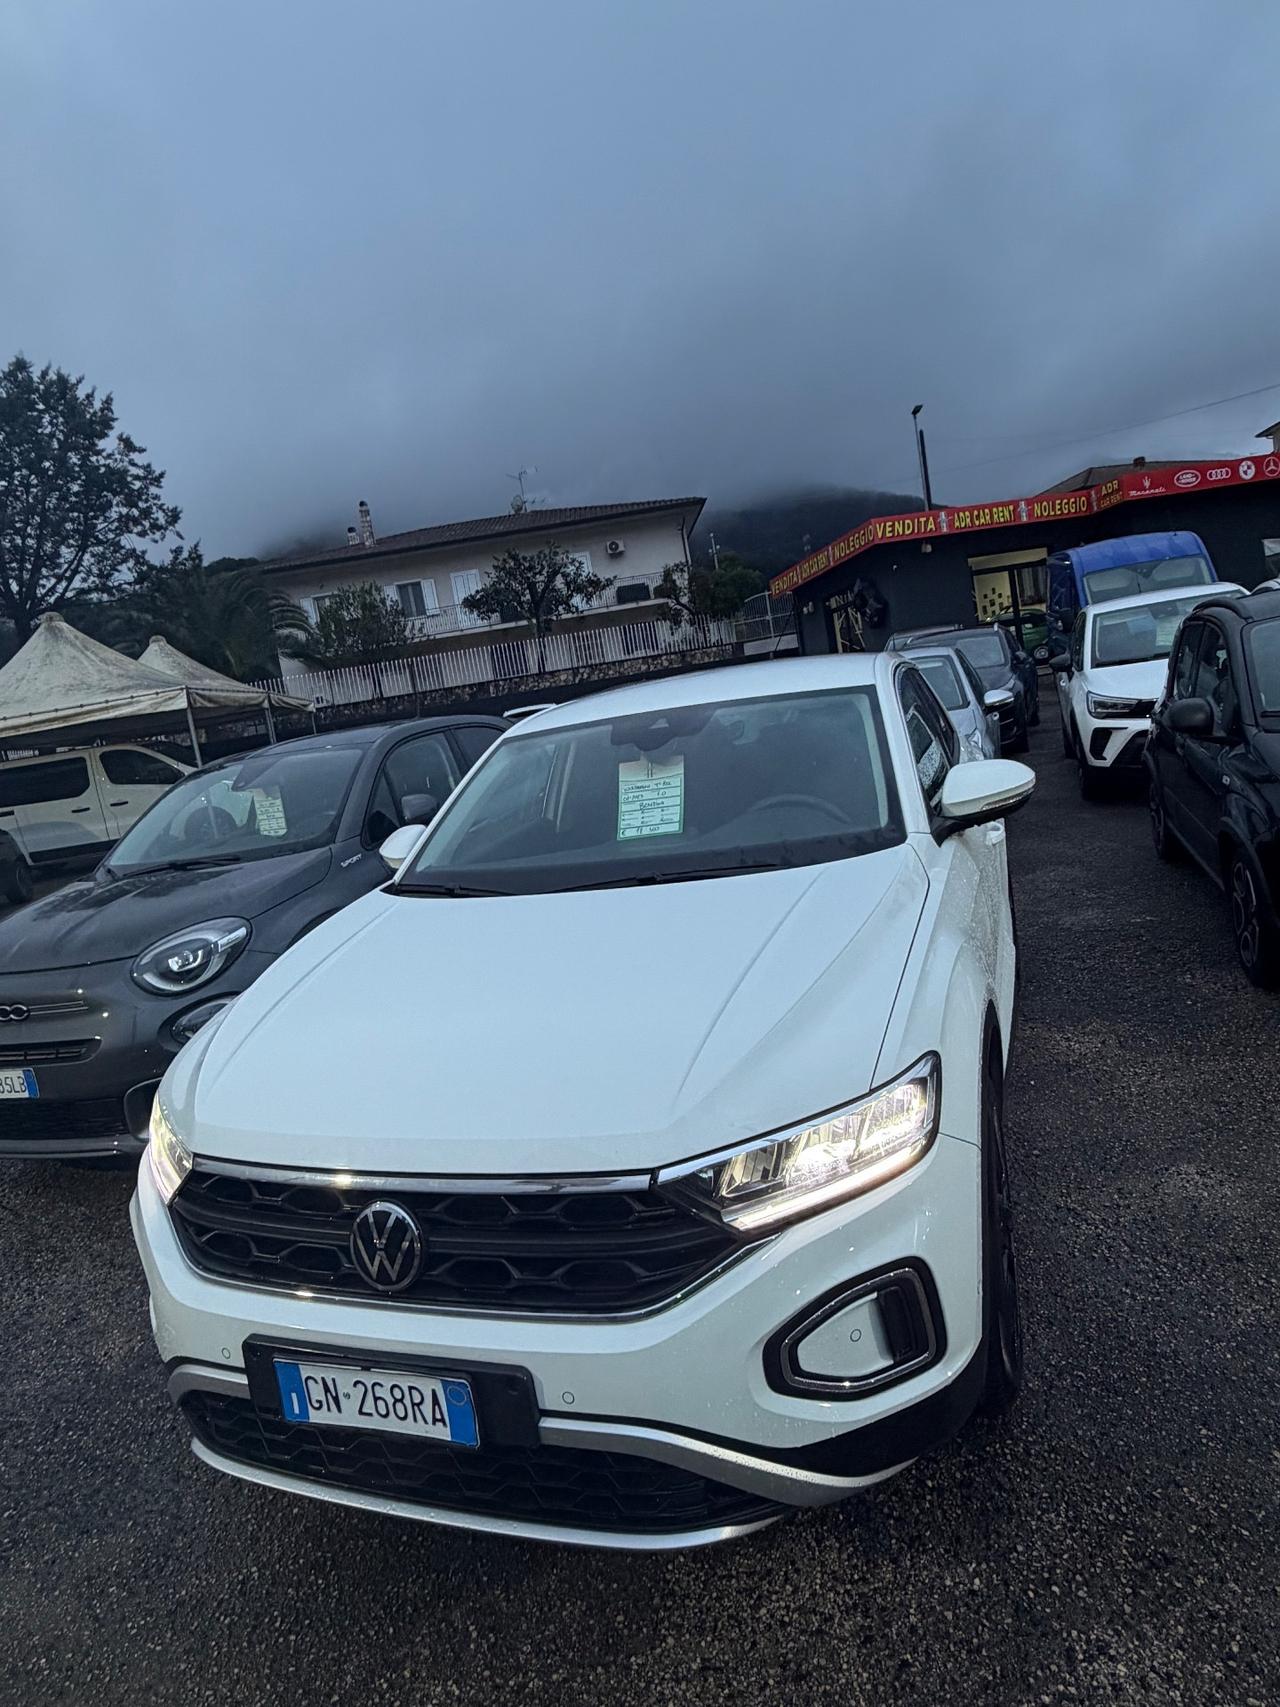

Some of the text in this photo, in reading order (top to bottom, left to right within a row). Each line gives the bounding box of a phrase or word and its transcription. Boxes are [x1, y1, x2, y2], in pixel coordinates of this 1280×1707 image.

[1101, 480, 1119, 496] ADR
[876, 496, 1087, 539] VENDITA ADR CAR RENT NOLEGGIO
[771, 570, 799, 596] VENDITA
[833, 525, 874, 561] NOLEGGIO
[304, 1375, 343, 1414] GN
[353, 1379, 448, 1428] 268RA
